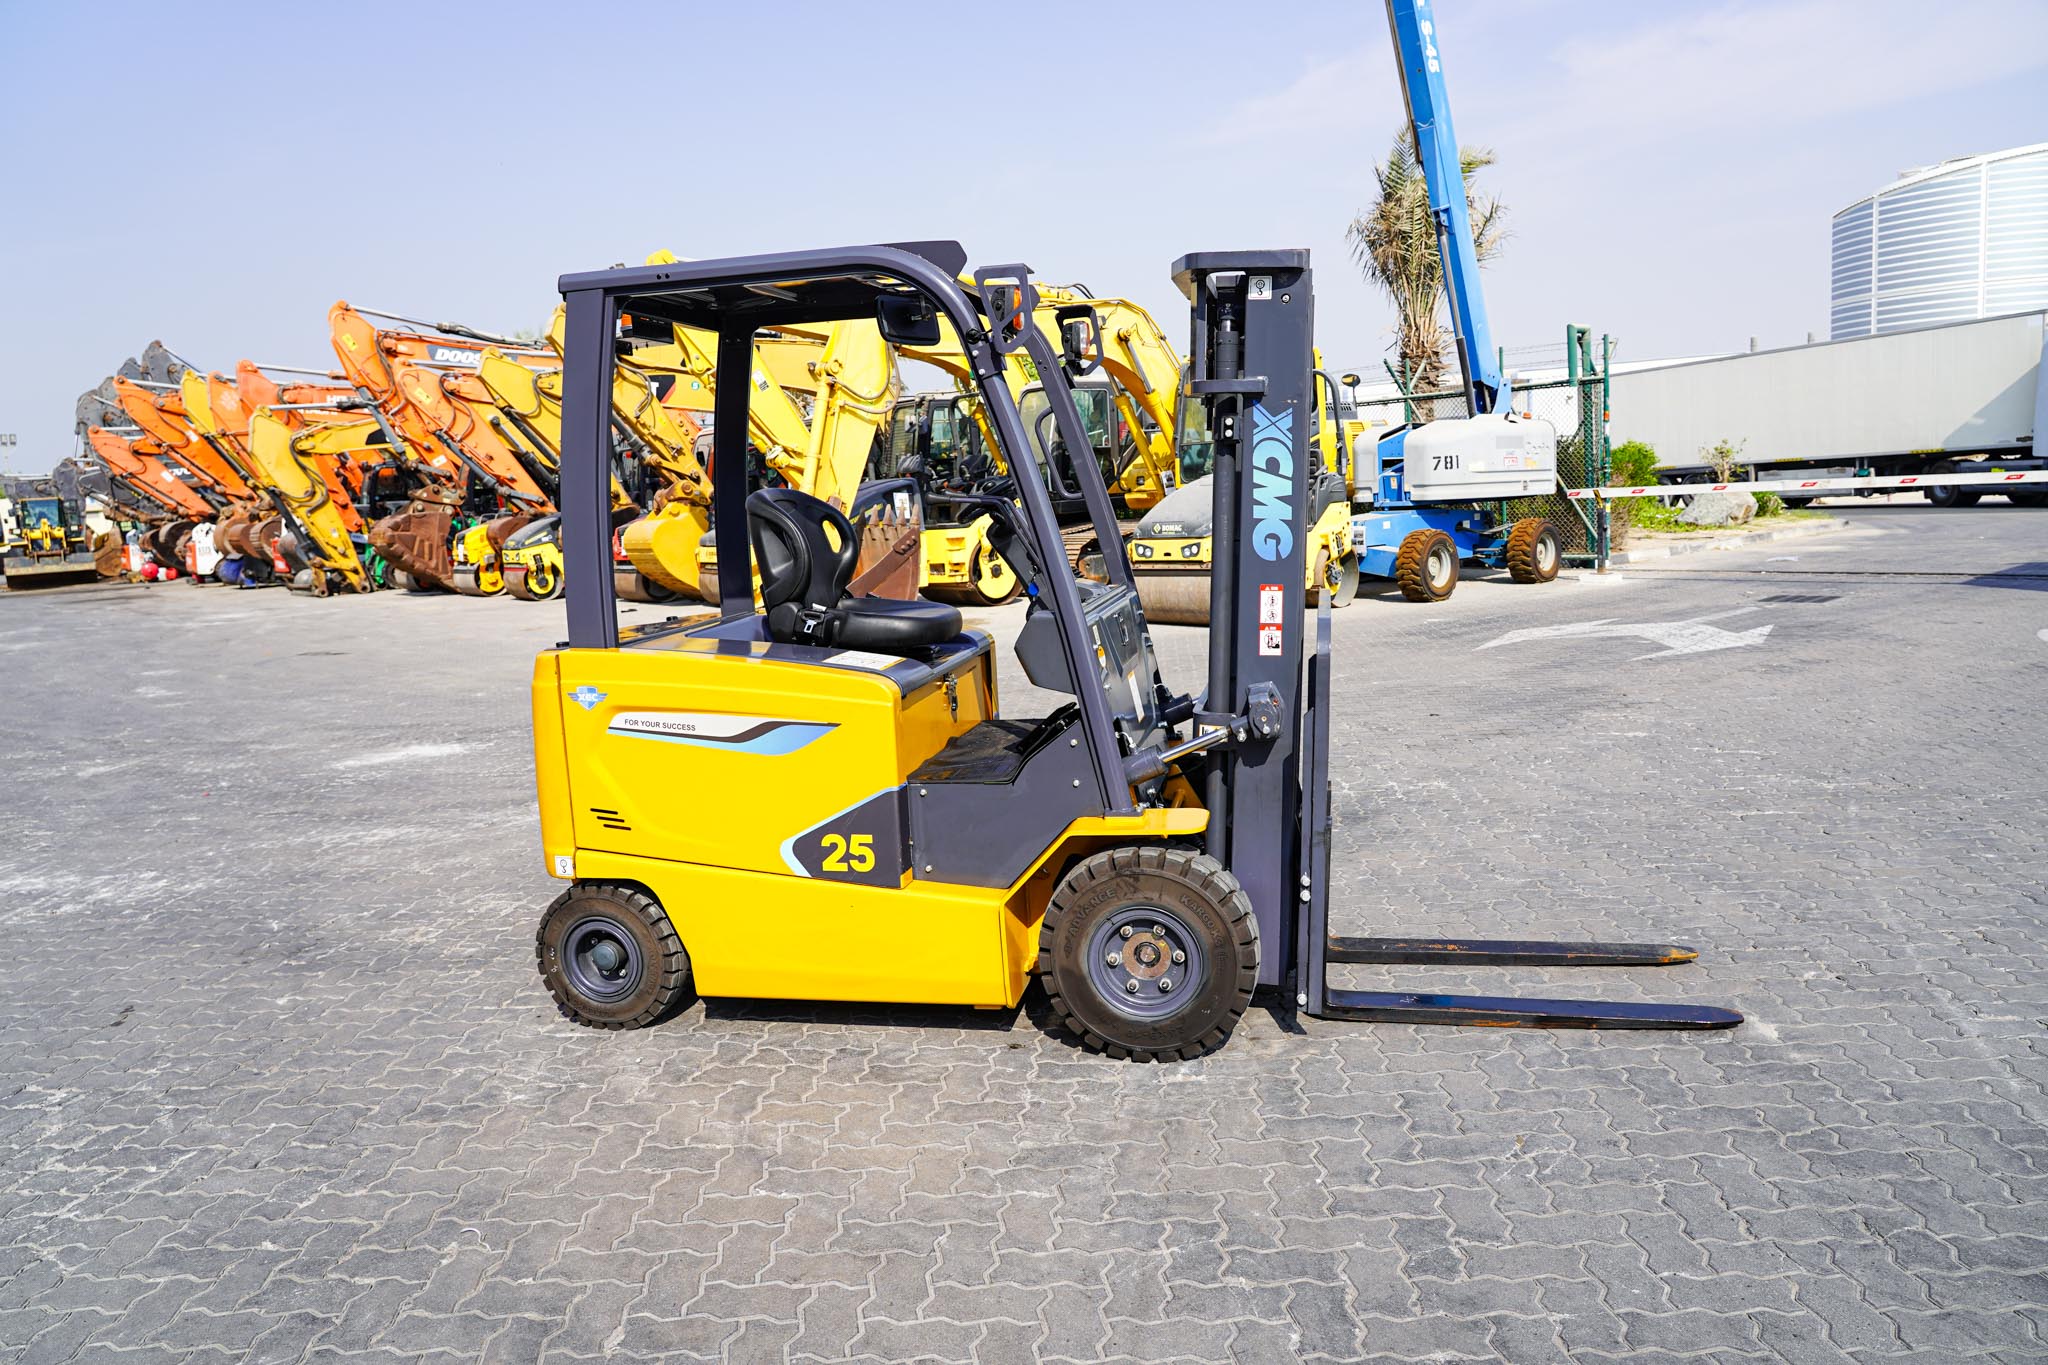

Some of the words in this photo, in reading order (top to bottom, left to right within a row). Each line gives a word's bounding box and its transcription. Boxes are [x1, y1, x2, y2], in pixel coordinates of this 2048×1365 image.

[1252, 400, 1293, 562] XCMG
[1432, 455, 1460, 471] 781
[640, 720, 661, 728] YOUR
[662, 722, 696, 731] SUCCESS
[820, 833, 876, 873] 25
[1069, 889, 1116, 937] ADVANCE
